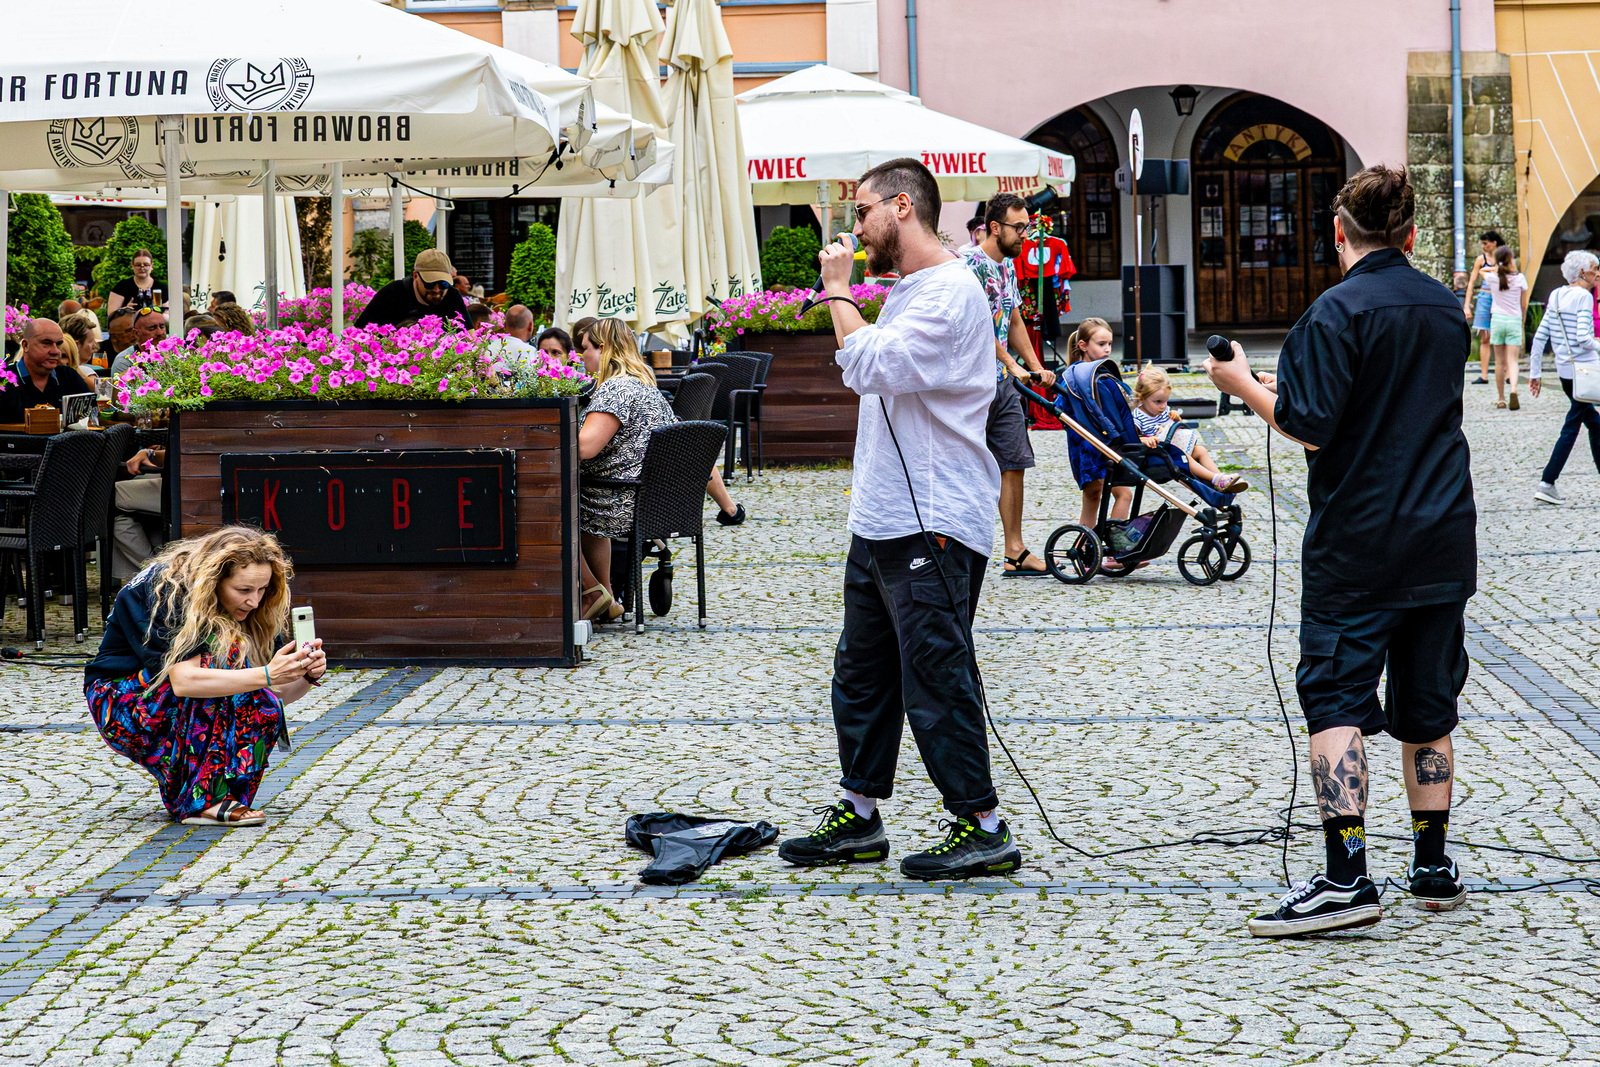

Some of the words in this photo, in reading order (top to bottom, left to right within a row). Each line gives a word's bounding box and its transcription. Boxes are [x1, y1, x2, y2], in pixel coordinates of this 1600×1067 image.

[0, 75, 26, 102] R
[45, 70, 188, 101] FORTUNA
[1230, 126, 1309, 158] ANTYKI
[263, 477, 474, 532] KOBE
